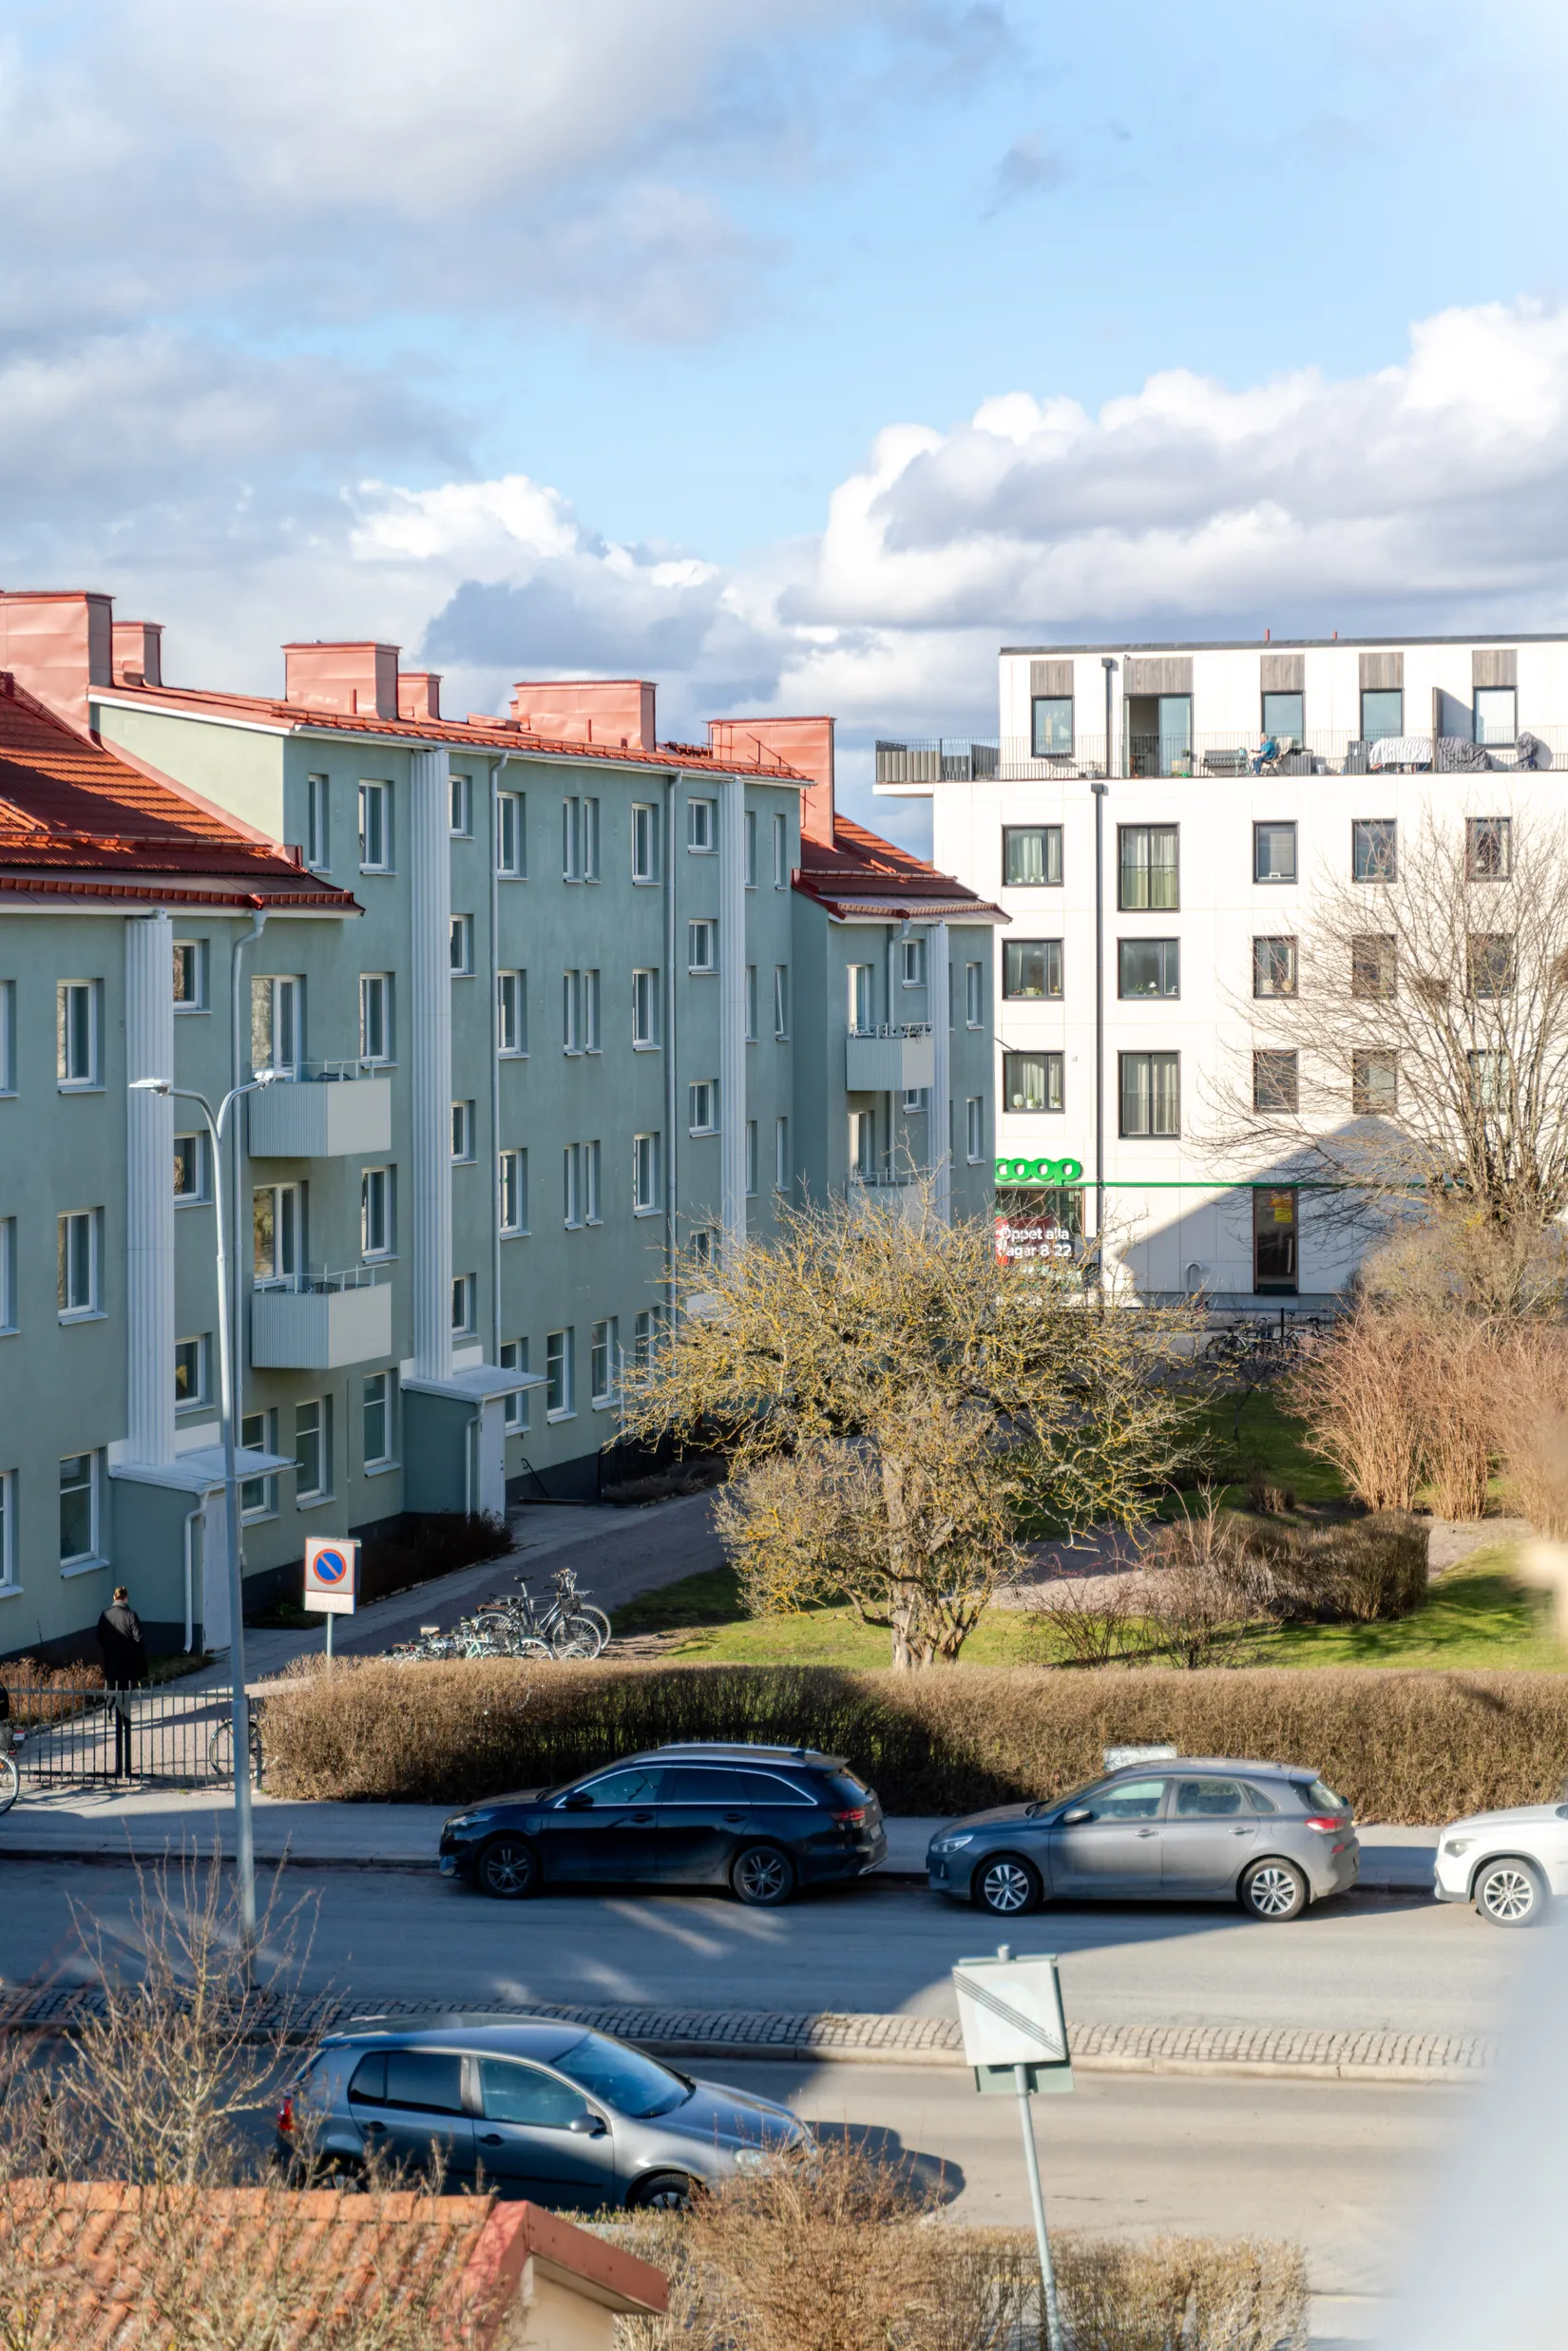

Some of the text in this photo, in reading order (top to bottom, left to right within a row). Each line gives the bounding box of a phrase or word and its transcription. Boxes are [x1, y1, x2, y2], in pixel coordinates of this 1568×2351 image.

[995, 1157, 1081, 1187] coop
[999, 1224, 1069, 1242] Öppet alla
